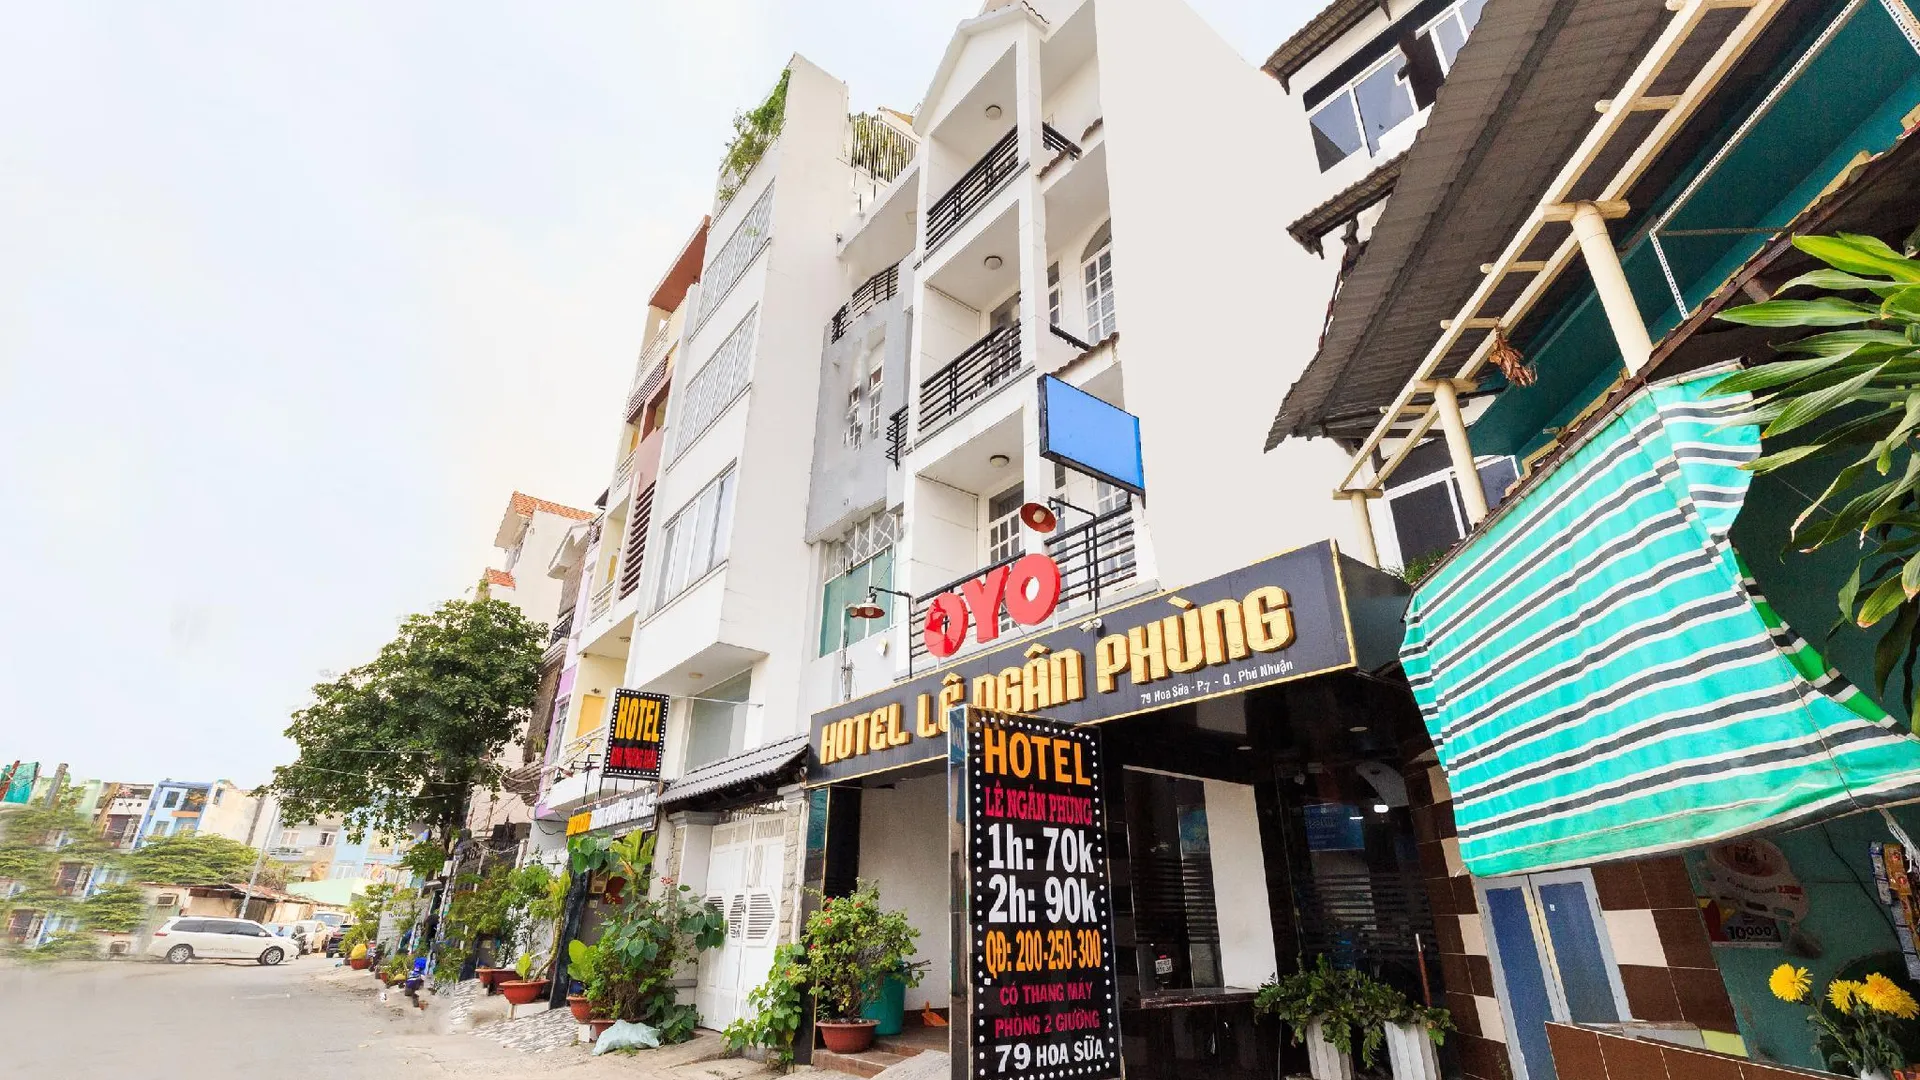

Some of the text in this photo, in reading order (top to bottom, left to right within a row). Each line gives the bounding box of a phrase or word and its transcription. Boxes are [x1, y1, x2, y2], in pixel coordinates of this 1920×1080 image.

[924, 553, 1061, 657] OYO
[820, 703, 911, 765] HOTEL
[917, 672, 964, 738] LÊ
[1096, 585, 1296, 693] PHÙNG
[1141, 693, 1151, 705] 79
[1154, 689, 1171, 702] Hoa
[1172, 684, 1189, 698] Sữa
[1238, 667, 1258, 682] Phú
[1260, 659, 1294, 679] Nhuận
[615, 697, 661, 742] HOTEL
[984, 727, 1092, 786] HOTEL
[984, 780, 1092, 826] LÊ NGÂN PHÙNG
[988, 823, 1095, 873] 1h: 70k
[988, 874, 1098, 923] 2h: 90k
[986, 929, 1012, 979] QĐ:
[1000, 978, 1093, 1006] CÓ THANG MÁY
[995, 1012, 1040, 1039] PHÒNG
[1044, 1013, 1052, 1033] 2
[995, 1035, 1105, 1073] 79 HOA SỮA
